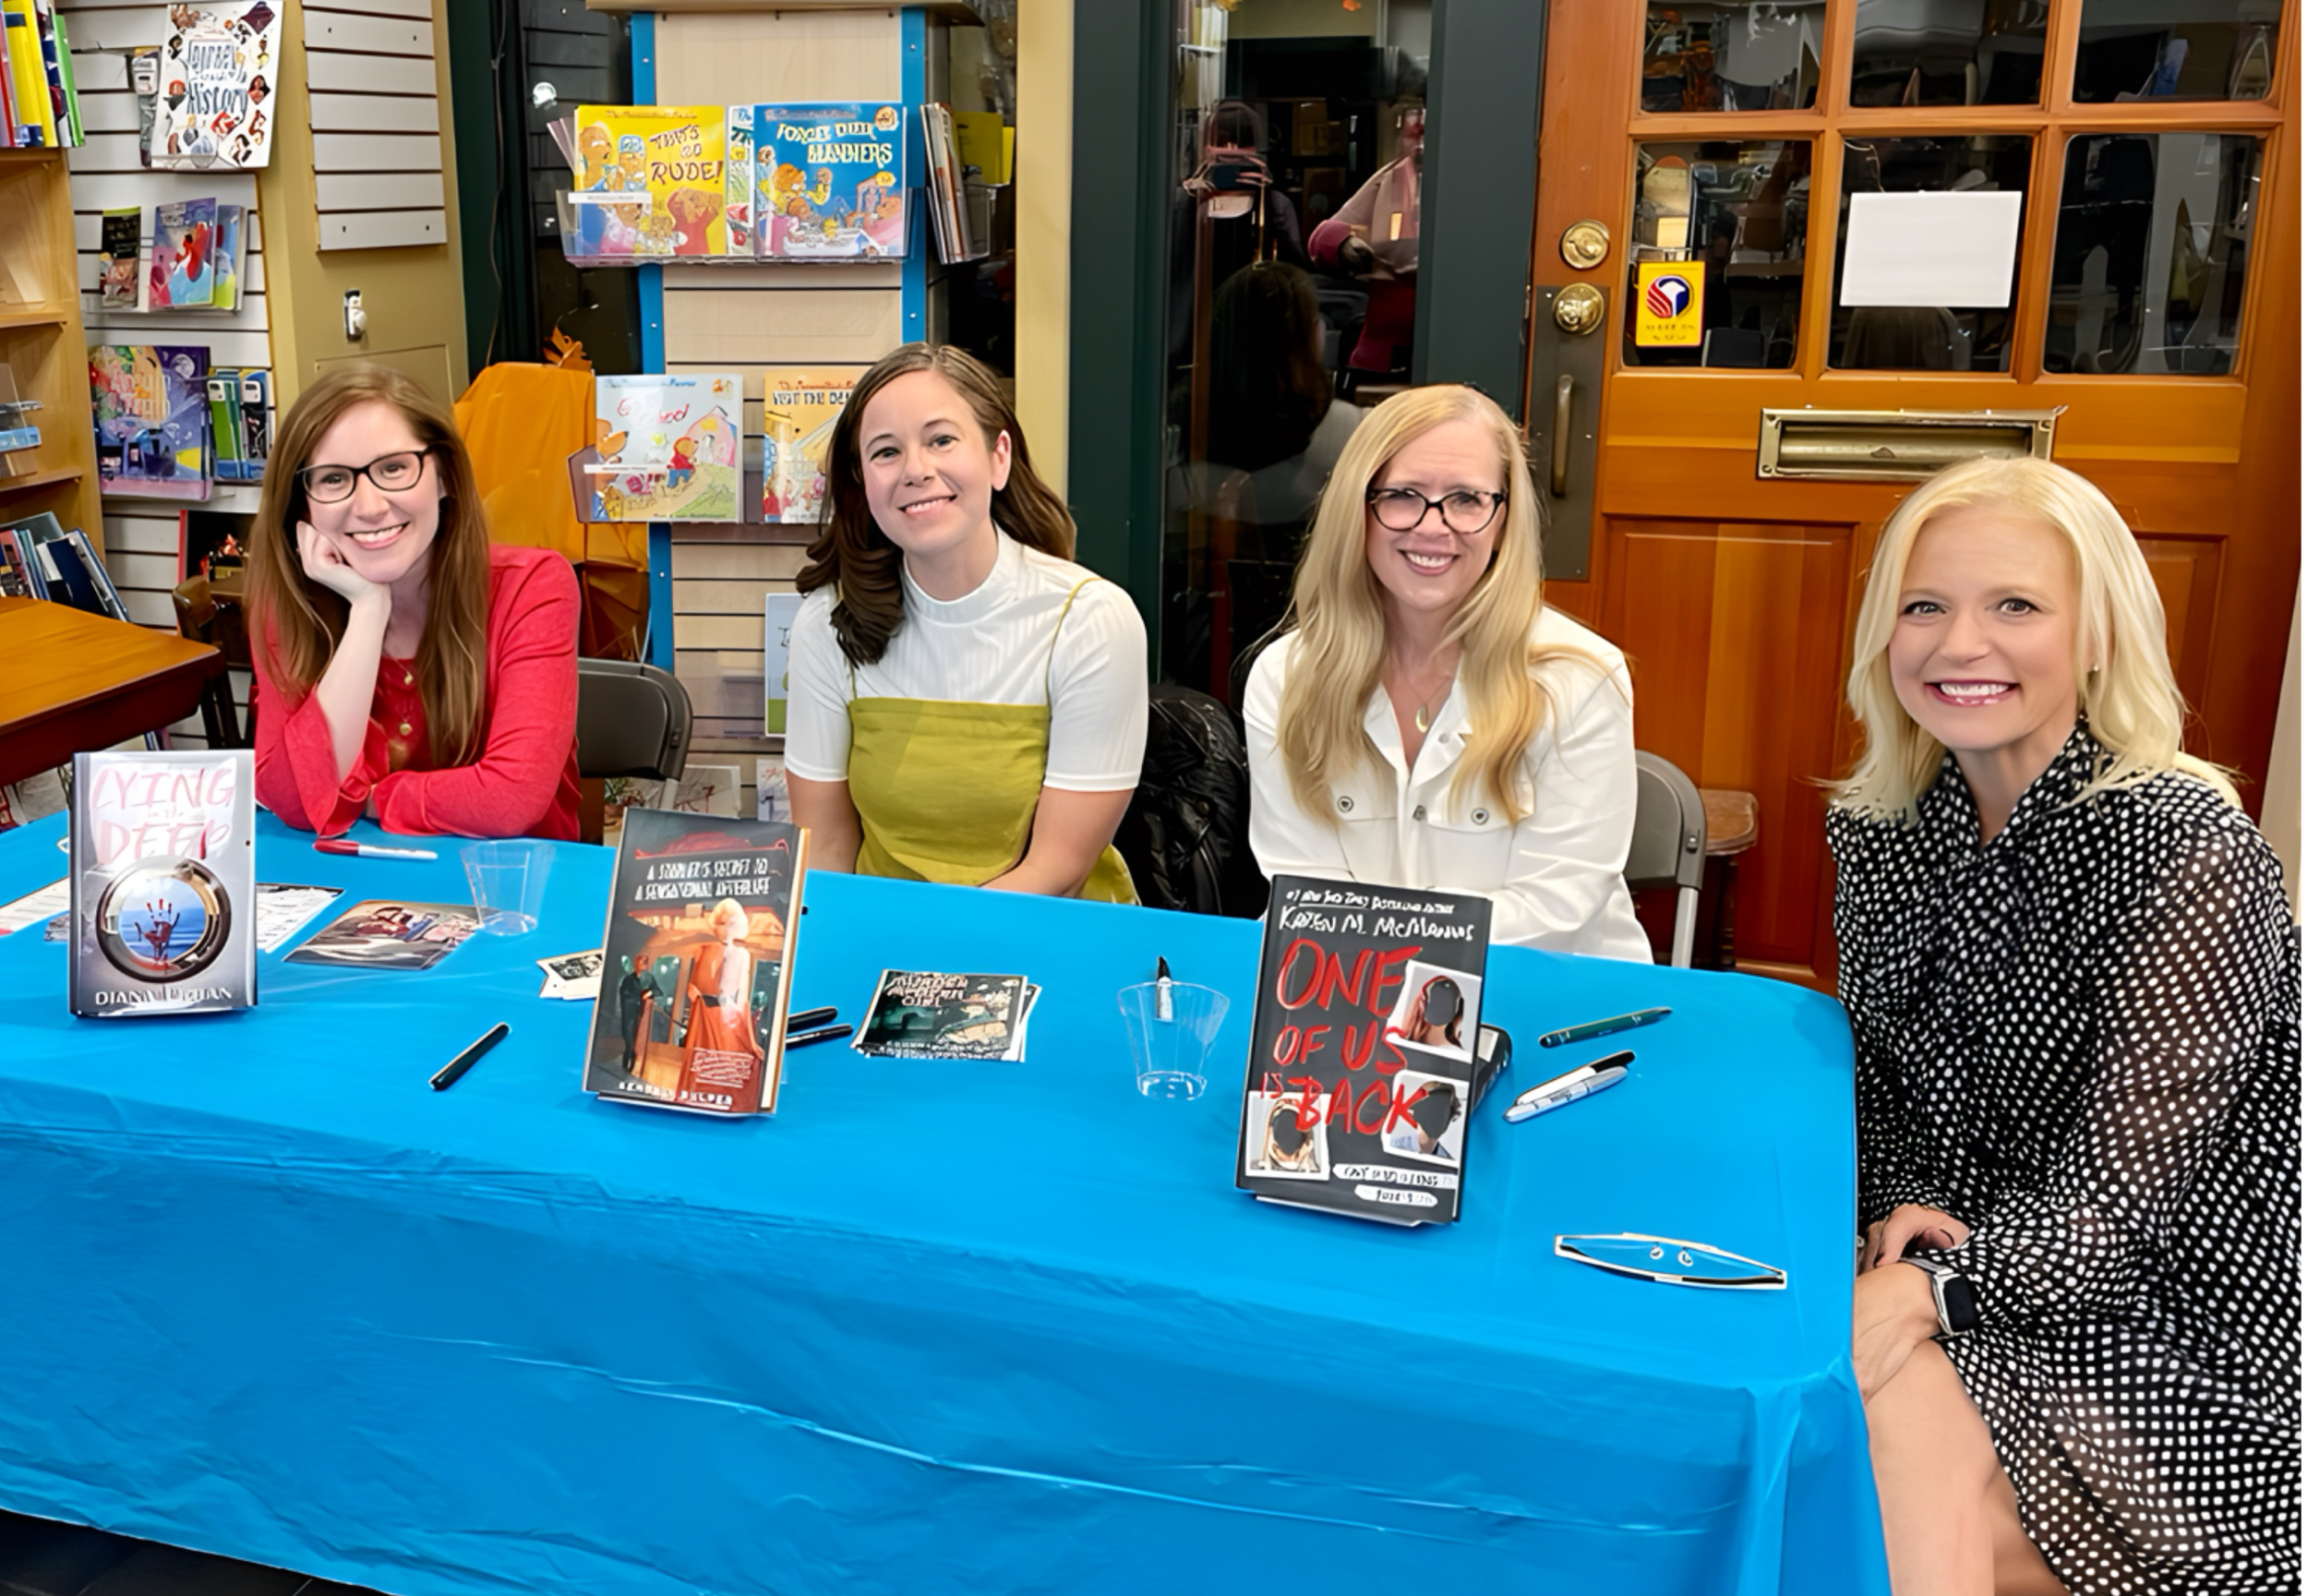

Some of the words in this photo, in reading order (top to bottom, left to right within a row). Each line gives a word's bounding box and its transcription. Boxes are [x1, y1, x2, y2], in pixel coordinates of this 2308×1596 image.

[651, 161, 724, 185] RUDE!
[92, 767, 234, 810] LYING
[1276, 938, 1423, 1018] ONE
[1273, 1025, 1332, 1066] OF
[1340, 1019, 1408, 1075] US
[1287, 1075, 1429, 1135] BACK
